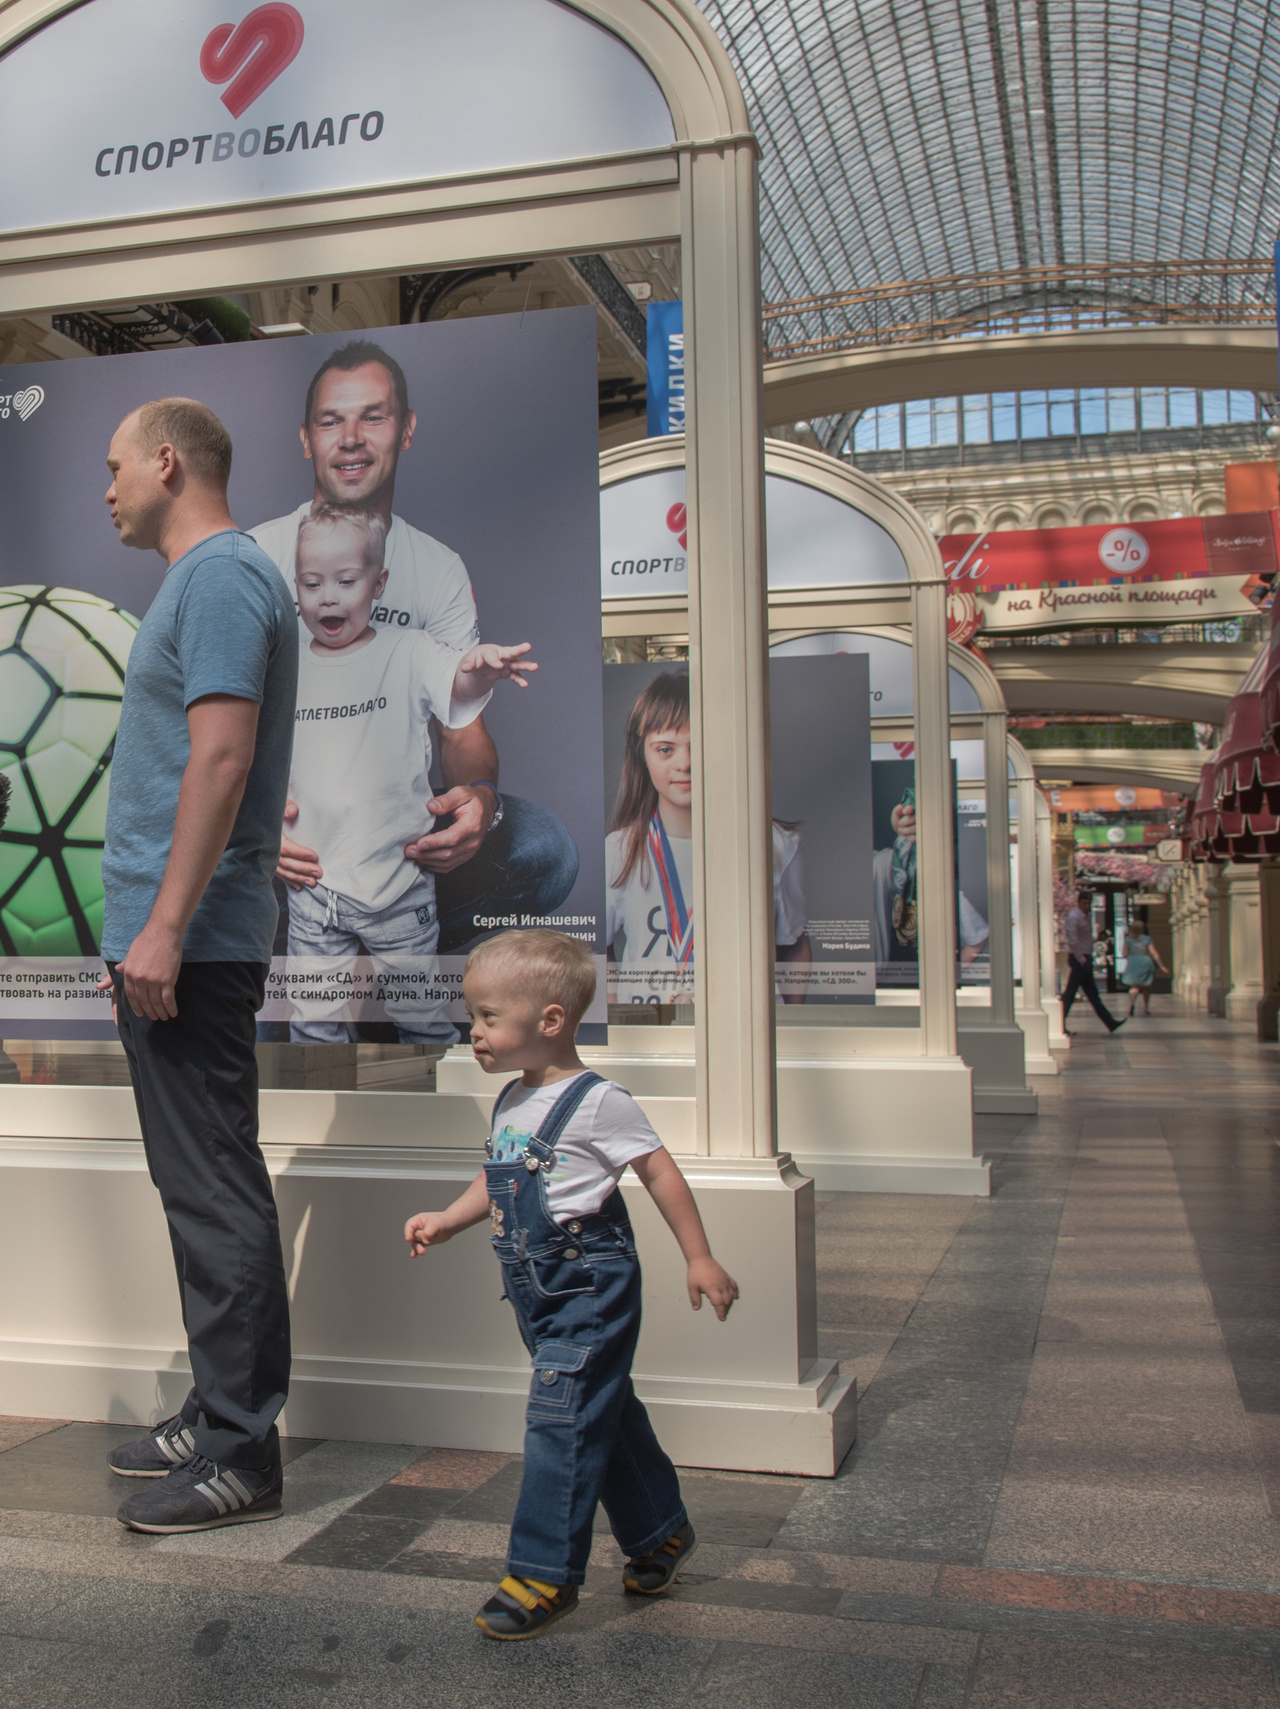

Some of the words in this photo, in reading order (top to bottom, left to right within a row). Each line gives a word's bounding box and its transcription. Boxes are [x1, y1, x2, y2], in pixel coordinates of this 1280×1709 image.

[95, 110, 385, 178] СПОРТВОБЛАГО
[1007, 598, 1032, 612] на
[1038, 586, 1123, 613] Красной
[1127, 586, 1218, 606] площади
[294, 696, 387, 722] АТЛЕТВОБЛАГО
[473, 913, 518, 929] Сергей
[520, 914, 597, 926] Игнашевич
[822, 942, 844, 951] Мария
[15, 973, 76, 985] отправить
[78, 971, 102, 983] СМС
[268, 971, 323, 986] буквами
[326, 972, 362, 984] «СД»
[366, 974, 374, 983] и
[377, 971, 430, 986] суммой,
[433, 974, 464, 984] кото
[47, 989, 61, 998] на
[64, 989, 112, 1001] развива
[265, 988, 288, 999] тей
[291, 990, 297, 999] с
[300, 990, 373, 1002] синдромом
[376, 988, 421, 1002] Дауна.
